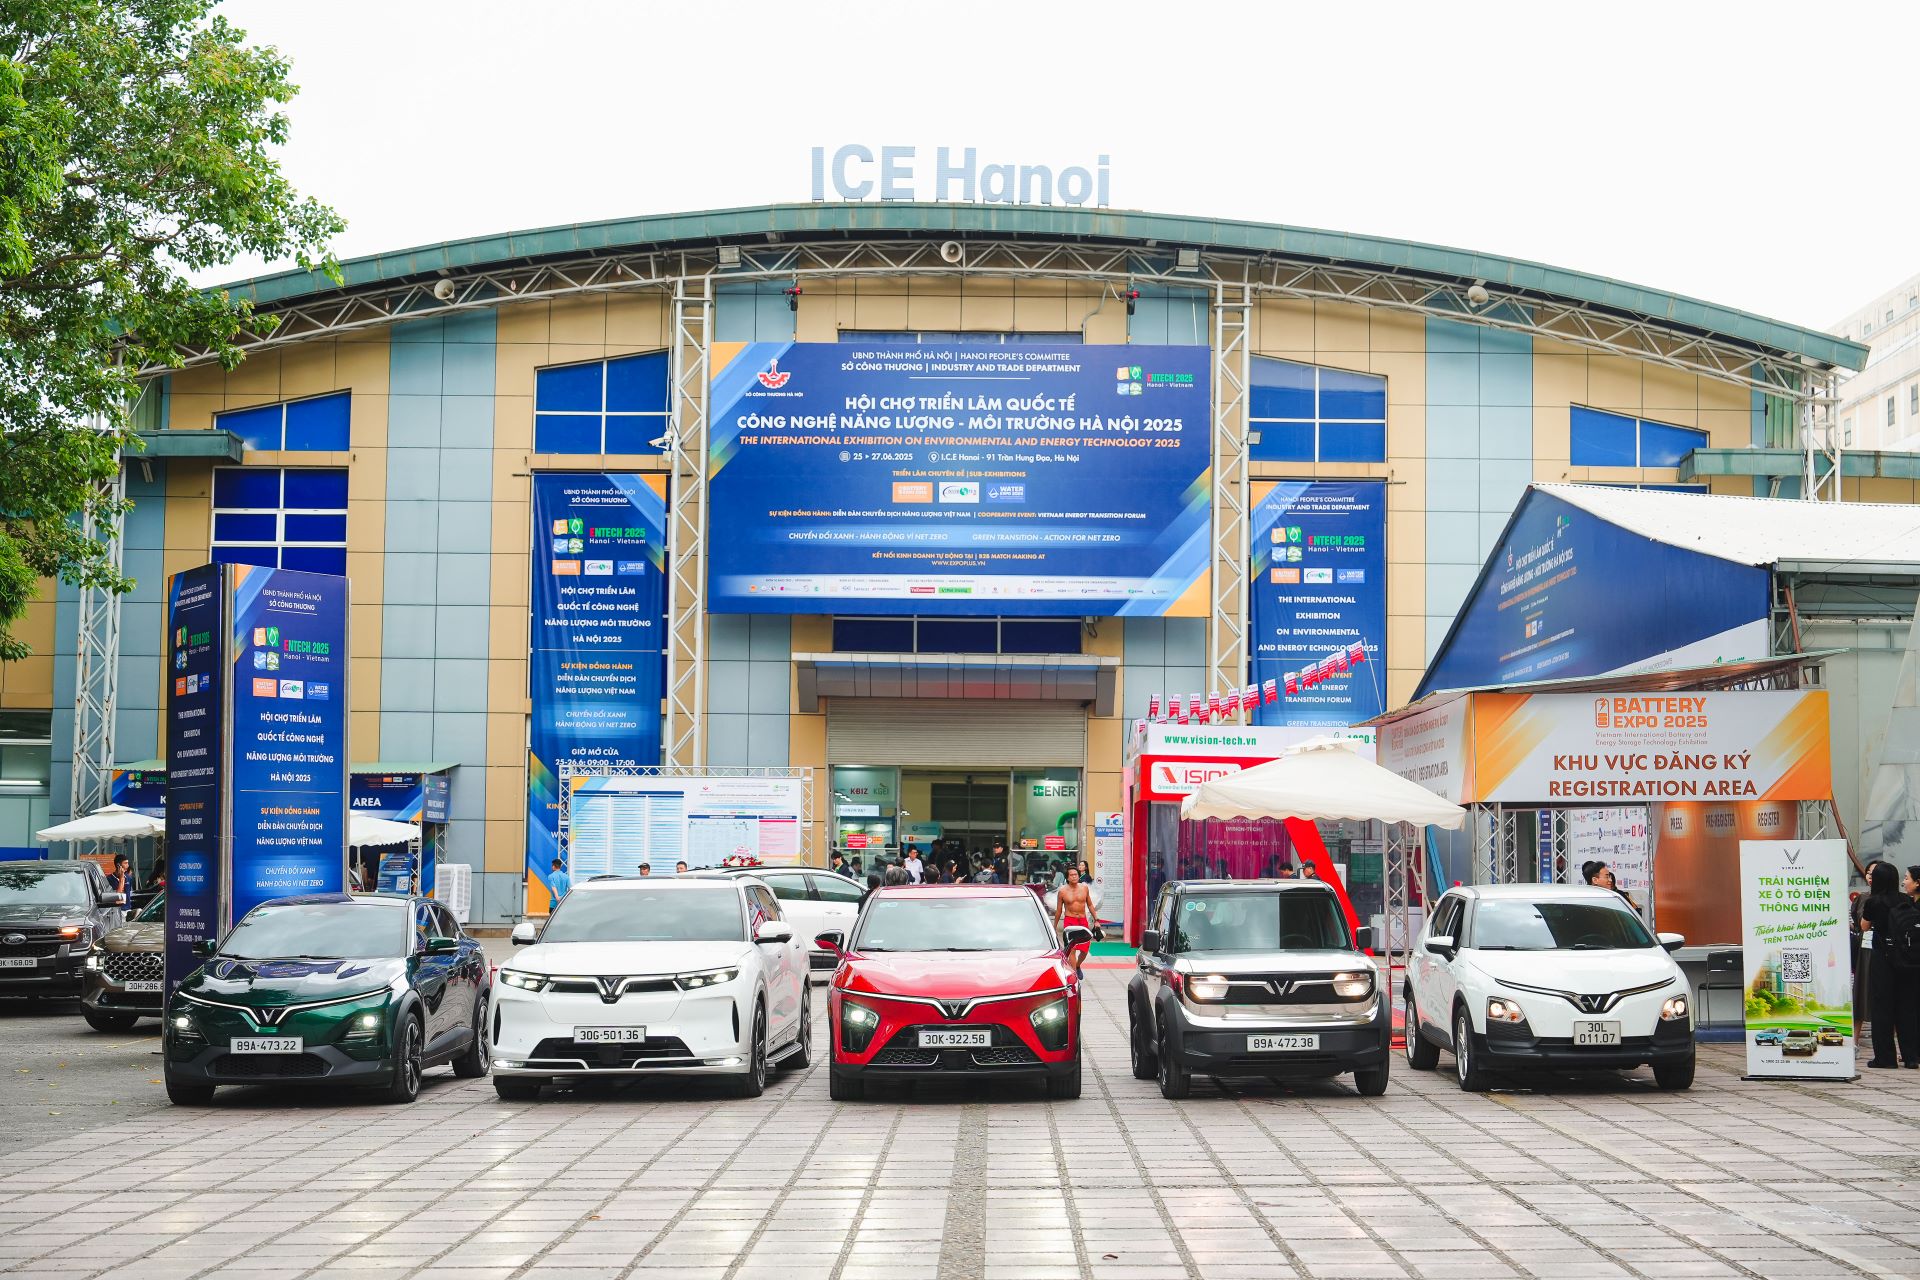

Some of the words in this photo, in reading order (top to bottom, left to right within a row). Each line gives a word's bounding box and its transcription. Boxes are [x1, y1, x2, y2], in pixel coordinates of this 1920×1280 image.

[812, 144, 915, 199] ICE
[936, 147, 1110, 205] Hanoi
[852, 352, 874, 360] UBND
[876, 350, 903, 360] THÀNH
[905, 350, 921, 360] PHỐ
[923, 350, 935, 360] HÀ
[937, 351, 952, 361] NỘI
[960, 352, 987, 360] HANOI
[1024, 353, 1070, 361] COMMITTEE
[841, 361, 854, 371] SỞ
[855, 361, 882, 371] CÔNG
[884, 362, 923, 371] THƯƠNG
[931, 363, 974, 371] INDUSTRY
[976, 363, 996, 371] AND
[997, 364, 1024, 372] TRADE
[1025, 364, 1081, 372] DEPARTMENT
[1147, 374, 1174, 383] ENTECH
[1175, 374, 1193, 383] 2025
[845, 394, 876, 412] HỘI
[880, 396, 916, 413] CHỢ
[919, 391, 963, 410] TRIỂN
[968, 394, 1001, 410] LÃM
[1006, 392, 1055, 411] QUỐC
[1058, 392, 1076, 411] TẾ
[737, 412, 786, 429] CÔNG
[790, 412, 836, 432] NGHỆ
[841, 413, 891, 429] NĂNG
[895, 416, 954, 432] LƯỢNG
[968, 414, 1001, 430] MÔI
[1006, 415, 1075, 430] TRƯỜNG
[1080, 414, 1103, 431] HÀ
[1108, 415, 1139, 434] NỘI
[1143, 418, 1183, 432] 2025
[740, 436, 758, 445] THE
[760, 436, 841, 445] INTERNATIONAL
[843, 436, 902, 445] EXHIBITION
[904, 437, 922, 445] ON
[924, 437, 1012, 446] ENVIRONMENTAL
[1014, 437, 1037, 446] AND
[1039, 438, 1080, 447] ENERGY
[1083, 438, 1153, 447] TECHNOLOGY
[1155, 439, 1181, 448] 2025
[871, 453, 913, 461] 27.06.2025
[941, 453, 957, 461] I.C.E
[958, 453, 980, 461] Hanoi
[998, 453, 1015, 461] Trần
[1036, 454, 1052, 463] Đạo,
[1054, 454, 1065, 462] Hà
[1066, 454, 1080, 463] Nội
[590, 528, 623, 537] ENTECH
[624, 528, 646, 538] 2025
[1043, 534, 1070, 542] ACTION
[1308, 535, 1341, 545] ENTECH
[1343, 536, 1365, 545] 2025
[561, 587, 576, 596] HỘI
[577, 588, 594, 597] CHỢ
[595, 585, 617, 595] TRIỂN
[619, 586, 635, 595] LÃM
[1278, 596, 1293, 604] THE
[1295, 612, 1341, 620] EXHIBITION
[544, 618, 568, 626] NĂNG
[570, 619, 599, 628] LƯỢNG
[600, 618, 616, 627] MÔI
[617, 618, 651, 627] TRƯỜNG
[1276, 628, 1290, 636] ON
[573, 635, 584, 643] HÀ
[586, 635, 601, 644] NỘI
[284, 640, 311, 653] ENTECH
[312, 641, 330, 654] 2025
[1614, 697, 1707, 713] BATTERY
[1614, 715, 1658, 728] EXPO
[1663, 715, 1708, 728] 2025
[1164, 735, 1257, 746] www.vision-tech.vn
[1669, 731, 1694, 739] Battery
[1595, 739, 1617, 747] Energy
[1643, 739, 1677, 747] Technology
[1554, 754, 1598, 771] KHU
[1605, 753, 1648, 775] VỰC
[1654, 751, 1717, 771] ĐĂNG
[1723, 749, 1751, 771] KÝ
[1159, 767, 1237, 784] VISIO
[850, 787, 869, 795] KBIZ
[1044, 785, 1078, 797] ENER
[1549, 780, 1697, 797] REGISTRATION
[1703, 780, 1758, 796] AREA
[352, 797, 381, 807] AREA
[1670, 817, 1683, 830] PRESS
[1757, 811, 1780, 827] REGISTER
[1758, 875, 1784, 886] TRẢI
[1786, 875, 1830, 888] NGHIỆM
[1758, 890, 1772, 899] XE
[1775, 889, 1784, 899] Ô
[1786, 889, 1801, 899] TÔ
[1803, 889, 1831, 901] ĐIỆN
[1759, 901, 1798, 912] THÔNG
[1802, 903, 1830, 912] MINH
[1776, 923, 1795, 933] khai
[1763, 936, 1782, 944] TRÊN
[1784, 933, 1805, 942] TOÀN
[1806, 929, 1828, 940] QUỐC
[1587, 1022, 1608, 1033] 30L
[579, 1027, 641, 1041] 30G-501.36
[925, 1034, 985, 1044] 30K-922.58
[1579, 1033, 1616, 1043] 011.07
[236, 1039, 297, 1052] 89A-473.22
[1252, 1037, 1314, 1049] 89A-472.38
